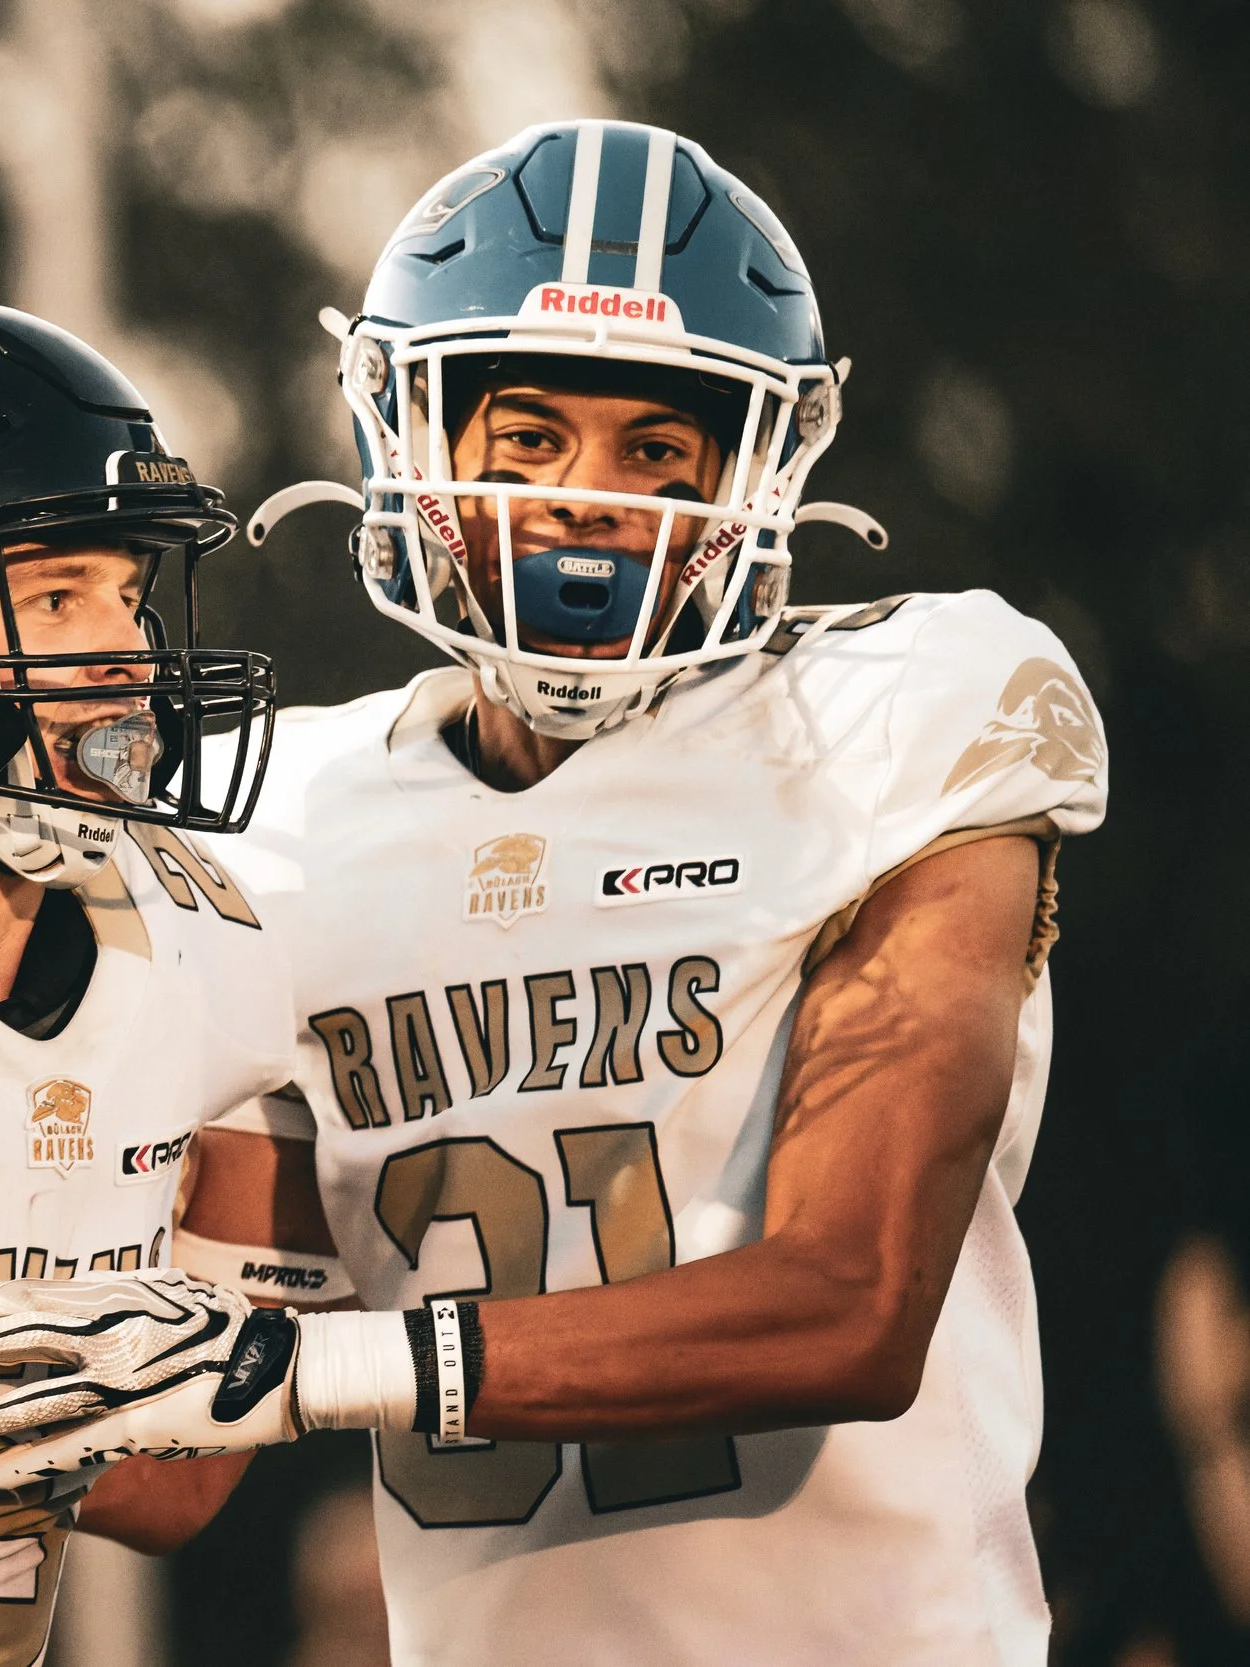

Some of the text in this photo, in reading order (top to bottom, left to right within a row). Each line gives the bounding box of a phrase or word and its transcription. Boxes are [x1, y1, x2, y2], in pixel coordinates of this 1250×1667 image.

[541, 288, 666, 321] Riddell
[413, 465, 466, 560] ddell
[537, 680, 601, 700] Riddell
[469, 885, 546, 914] RAVENS
[308, 955, 725, 1131] RAVENS
[33, 1138, 94, 1161] RAVENS
[441, 1331, 457, 1367] OUT
